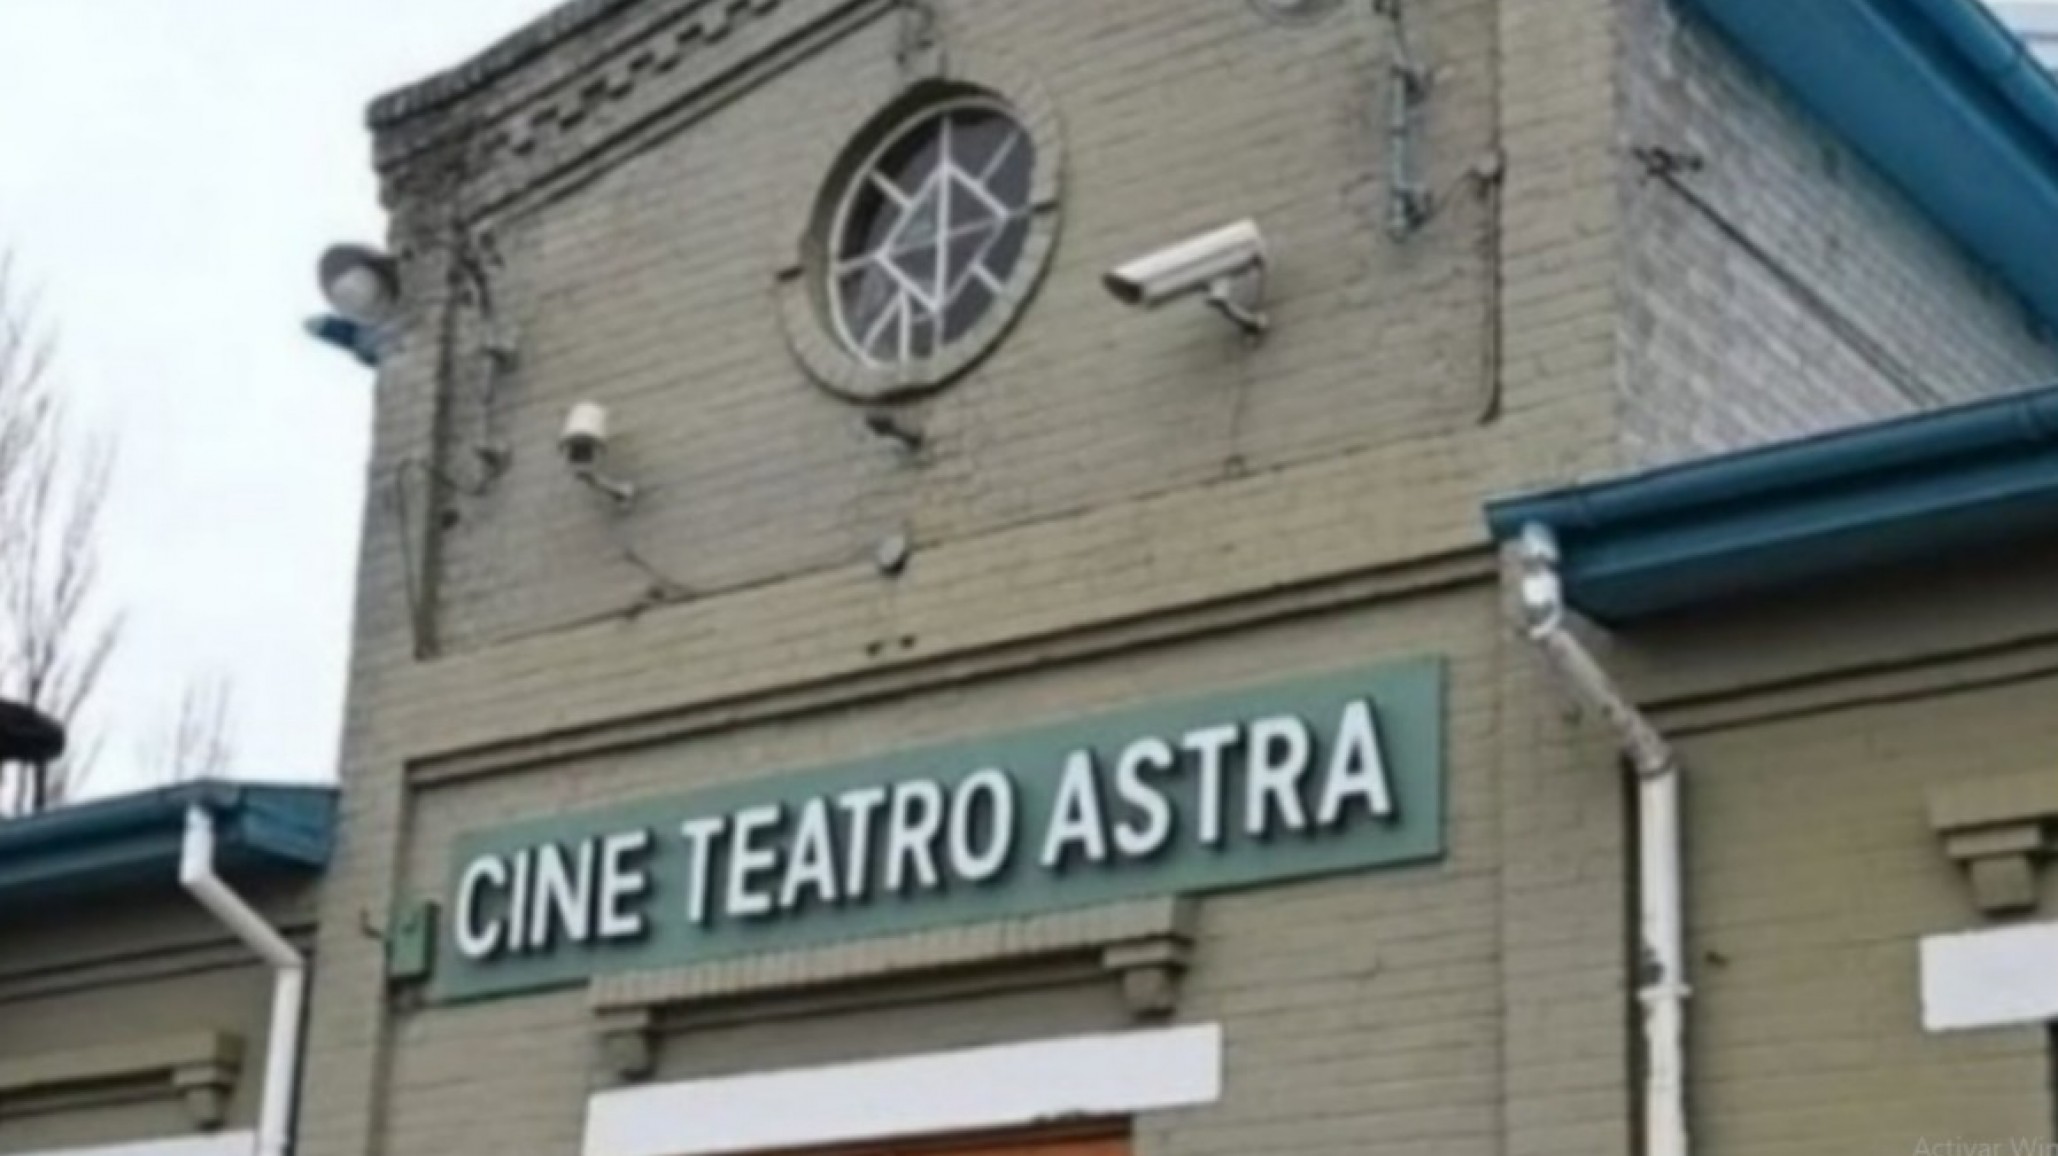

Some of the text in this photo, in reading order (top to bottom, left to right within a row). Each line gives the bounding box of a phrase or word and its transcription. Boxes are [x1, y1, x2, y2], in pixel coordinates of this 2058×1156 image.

[455, 700, 1389, 958] CINE TEATRO ASTRA
